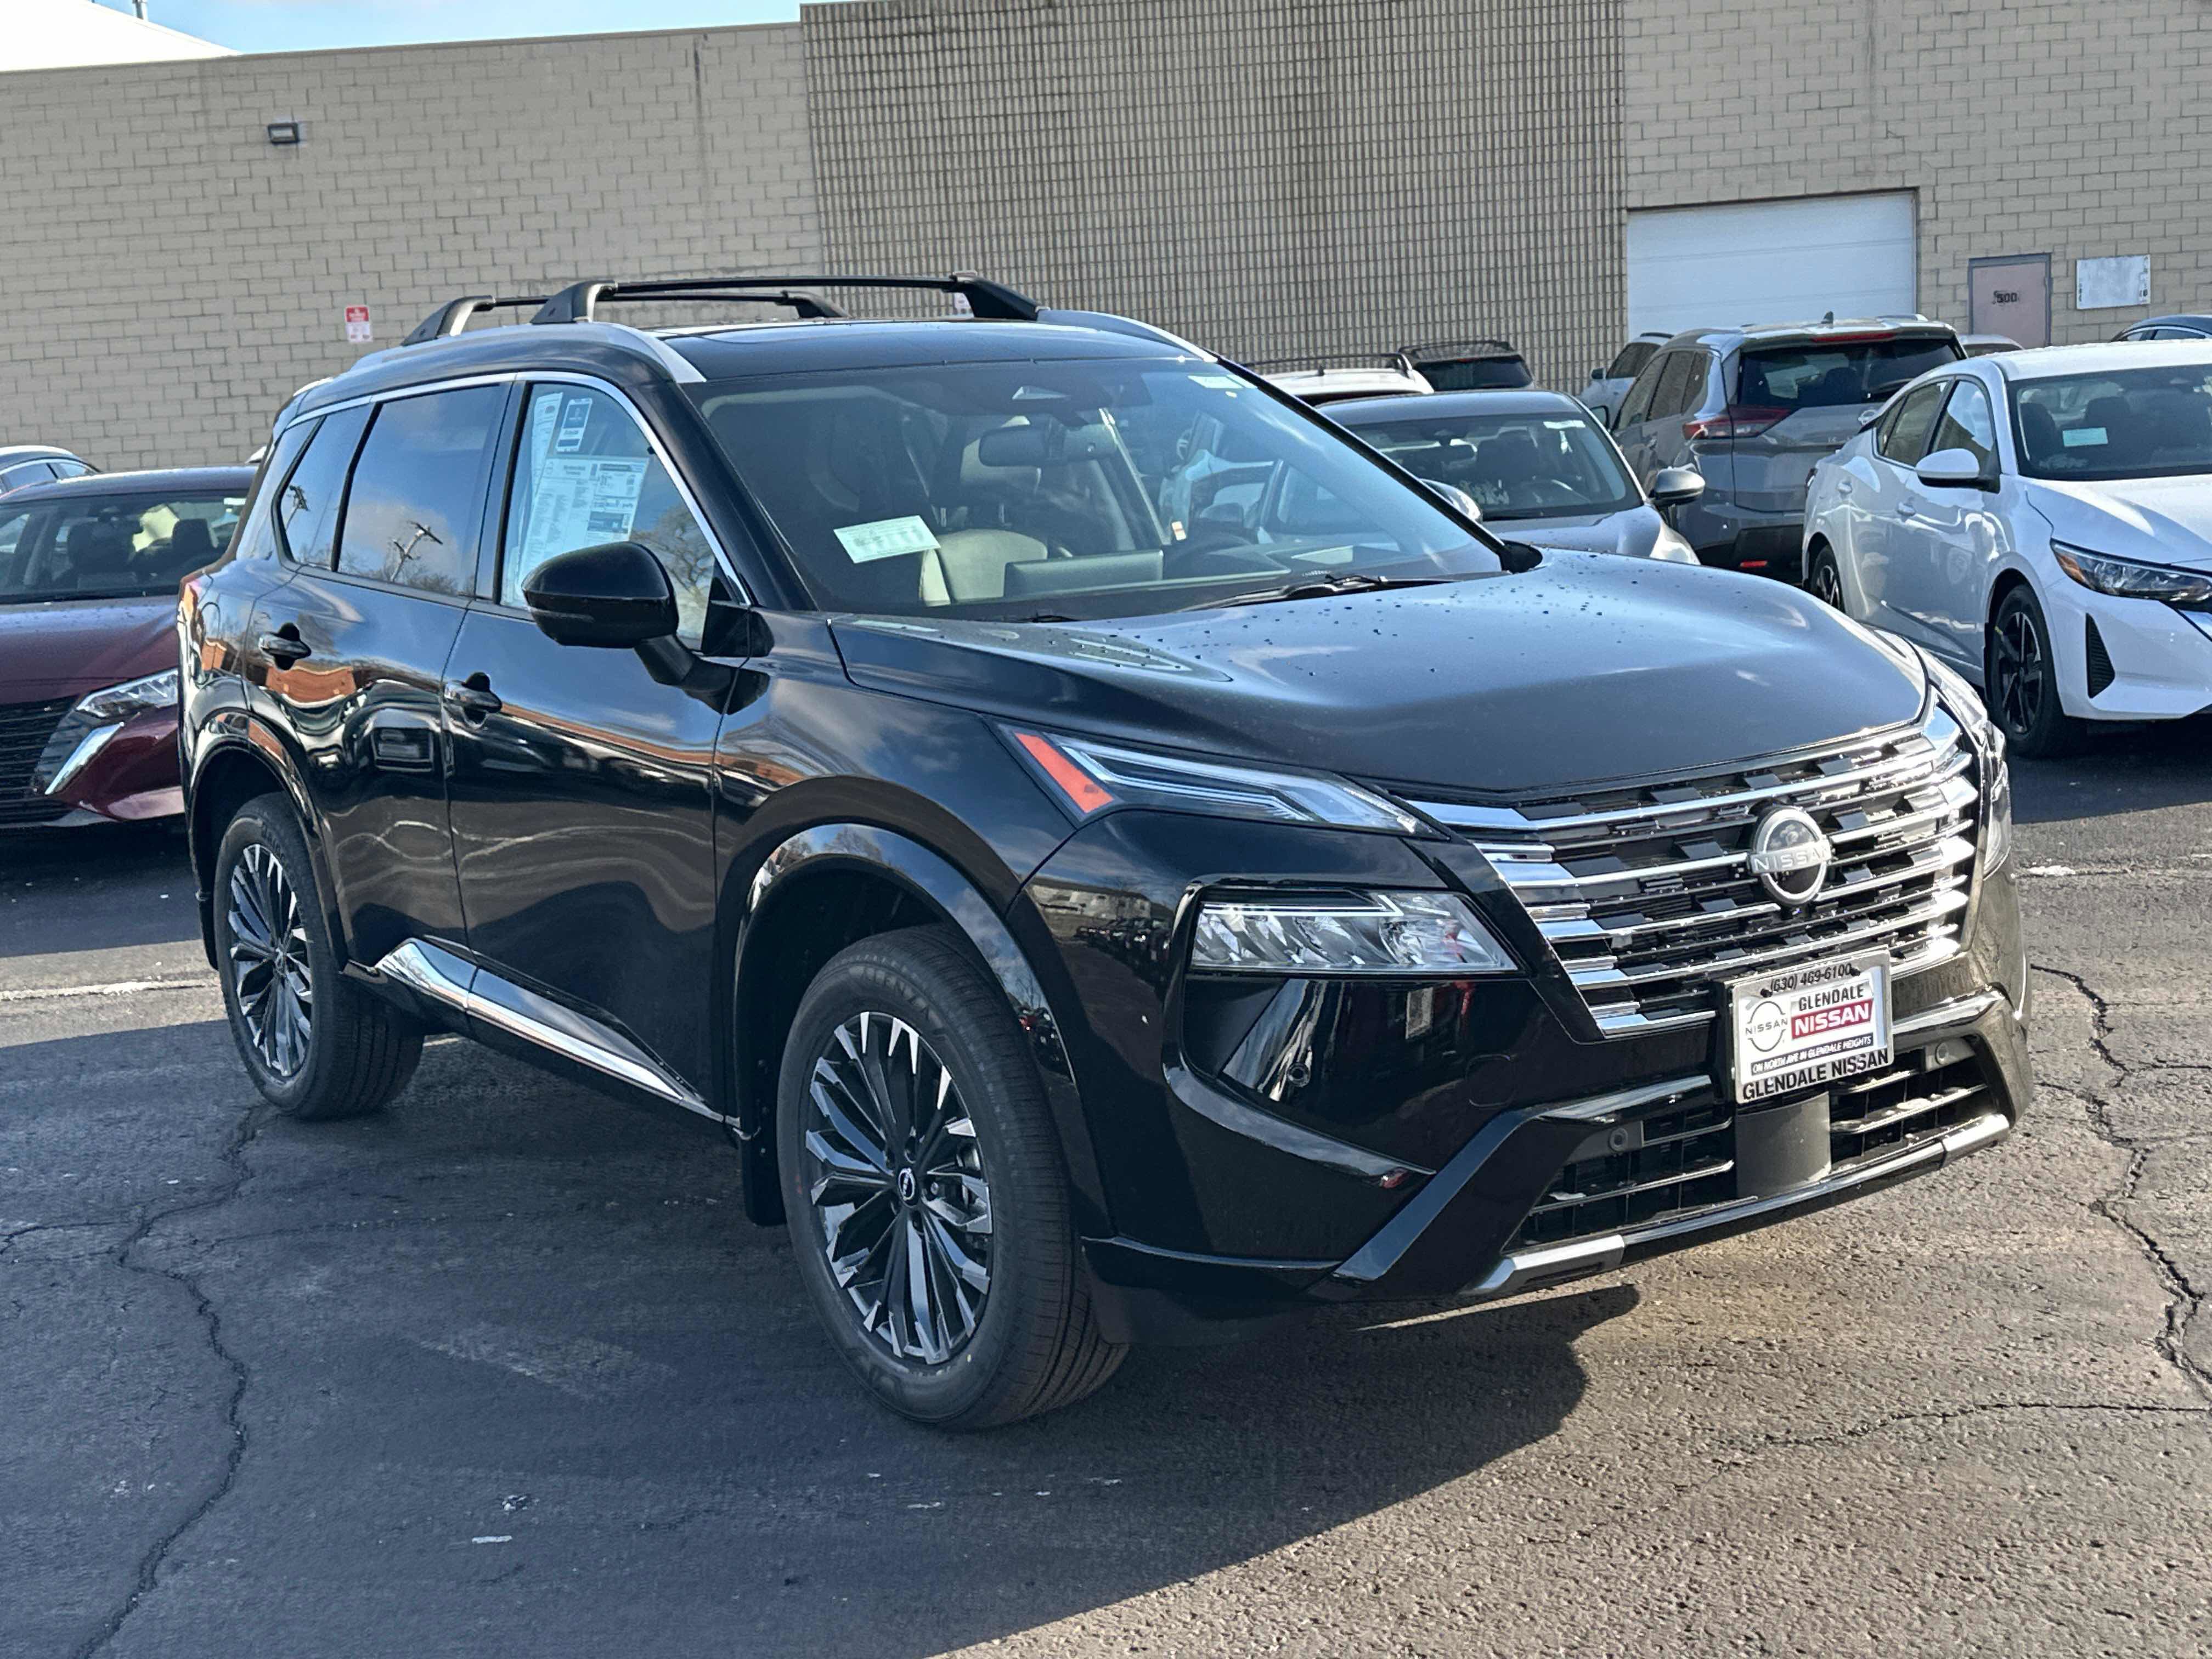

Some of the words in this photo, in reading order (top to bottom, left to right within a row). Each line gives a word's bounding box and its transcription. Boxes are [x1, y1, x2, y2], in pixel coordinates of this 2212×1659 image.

[1753, 843, 1829, 871] NISSAN
[1770, 974, 1797, 992] (630)
[1800, 963, 1853, 985] 469-6100
[1799, 984, 1864, 1011] GLENDALE
[1746, 1018, 1788, 1036] NISSAN
[1795, 1002, 1869, 1036] NISSAN
[1752, 1063, 1763, 1073] ON
[1843, 1035, 1872, 1049] HEIGHTS
[1742, 1063, 1827, 1100] GLENDALE
[1832, 1048, 1889, 1077] NISSAN
